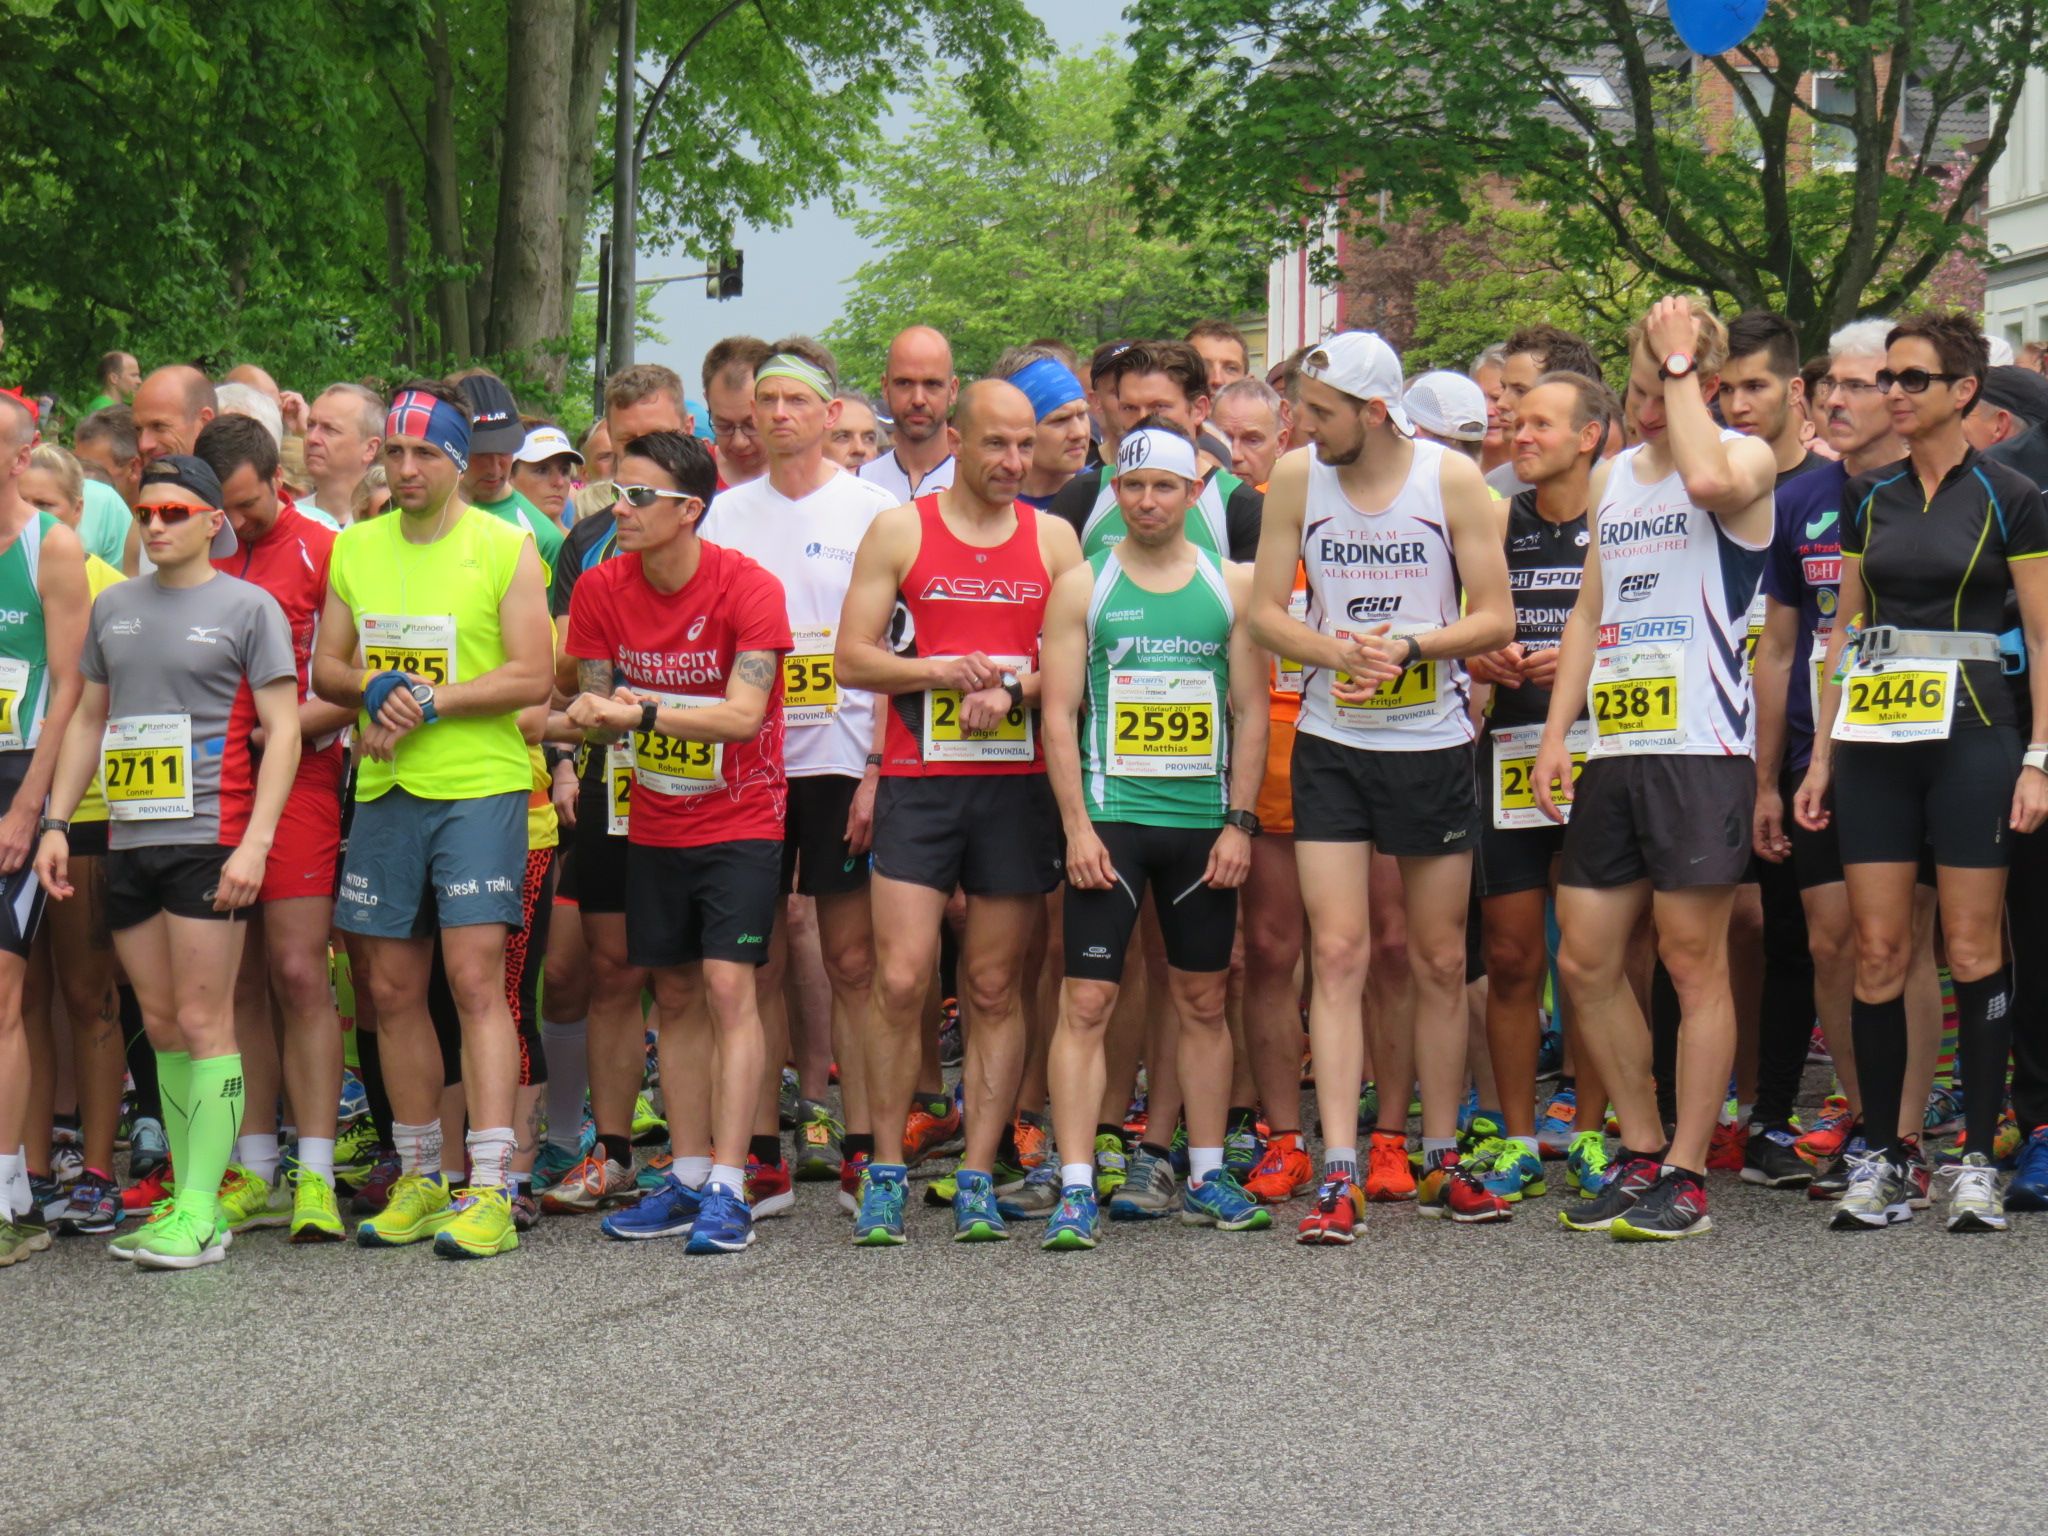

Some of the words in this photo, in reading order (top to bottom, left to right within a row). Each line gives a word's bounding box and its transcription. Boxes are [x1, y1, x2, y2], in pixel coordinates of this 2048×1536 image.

[473, 412, 505, 423] POLAR
[1348, 530, 1397, 541] TEAM
[1600, 513, 1688, 546] ERDINGER
[1320, 539, 1428, 566] ERDINGER
[1602, 539, 1687, 561] ALKOHOLFREI
[1321, 567, 1428, 580] ALKOHOLFREI
[1808, 563, 1833, 579] B&H
[920, 577, 1042, 604] ASAP
[411, 624, 444, 632] Itzehoer
[1136, 636, 1221, 656] Itzehoer
[679, 650, 717, 668] CITY
[1138, 655, 1201, 664] Versicherungen
[618, 661, 722, 686] MARATHON
[787, 663, 833, 693] 35
[1370, 697, 1403, 707] Fritjof
[1851, 679, 1942, 713] 2446
[1595, 686, 1671, 721] 2381
[1386, 708, 1437, 722] PROVINZIAL
[1879, 712, 1908, 721] Maike
[1118, 711, 1209, 741] 2593
[1891, 728, 1940, 738] PROVINZIAL
[638, 731, 711, 766] 2343
[1143, 744, 1188, 752] Matthias
[1629, 738, 1677, 747] PROVINZIAL
[981, 747, 1027, 756] PROVINZIAL
[107, 755, 177, 787] 2711
[658, 763, 685, 774] Robert
[1165, 762, 1209, 771] PROVINZIAL
[126, 788, 154, 797] Conner
[138, 804, 185, 814] PROVINZIAL
[485, 876, 514, 893] TRAIL
